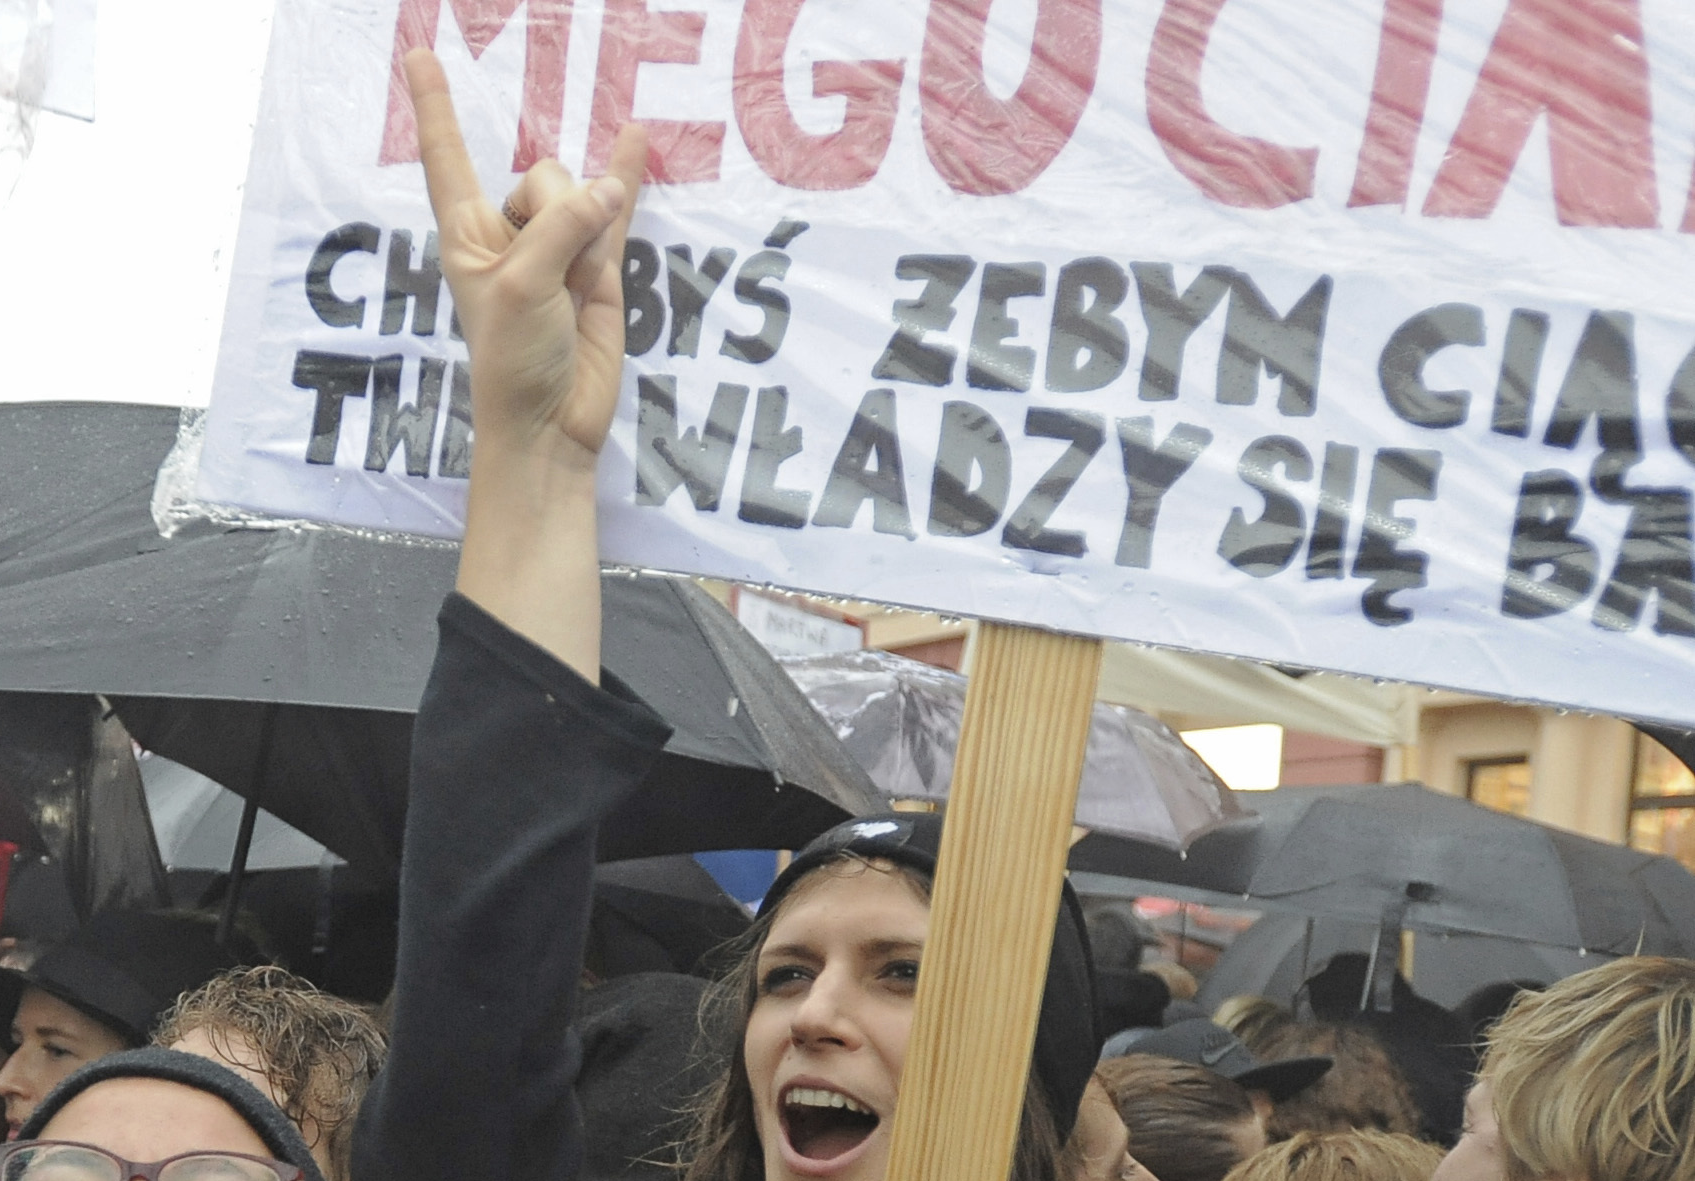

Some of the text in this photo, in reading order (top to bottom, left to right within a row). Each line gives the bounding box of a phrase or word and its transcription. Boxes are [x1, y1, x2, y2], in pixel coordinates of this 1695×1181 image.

[1144, 0, 1695, 234] CIA
[306, 219, 810, 364] CHBYŚ
[636, 373, 1214, 570] WŁADZY
[1216, 434, 1443, 628] SIĘ
